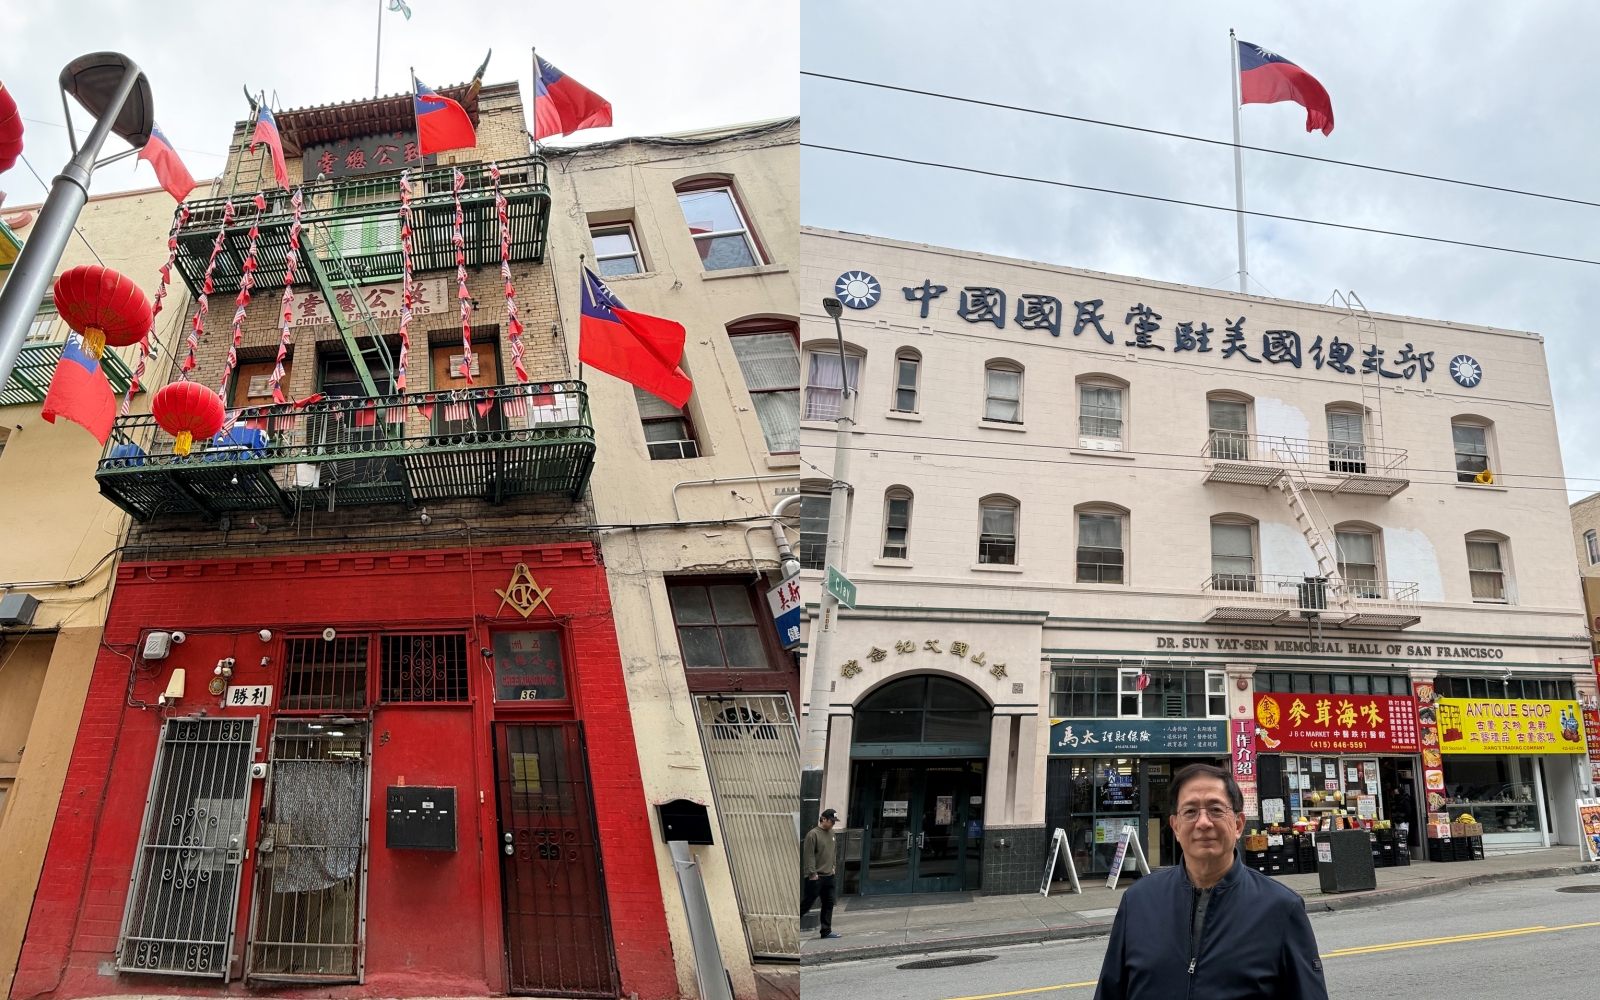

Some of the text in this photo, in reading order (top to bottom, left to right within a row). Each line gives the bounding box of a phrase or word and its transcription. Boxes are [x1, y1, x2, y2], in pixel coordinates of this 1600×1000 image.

[835, 577, 850, 602] Clay
[1157, 636, 1503, 660] DR. SUN YAT-SEN MEMORIAL HALL OF SAN FRANCISCO
[232, 687, 267, 705] 勝利
[522, 690, 536, 699] 36
[1288, 698, 1384, 728] 參茸海味
[1466, 703, 1552, 718] ANTIQUE SHOP
[1310, 740, 1367, 749] (415) 646-5591
